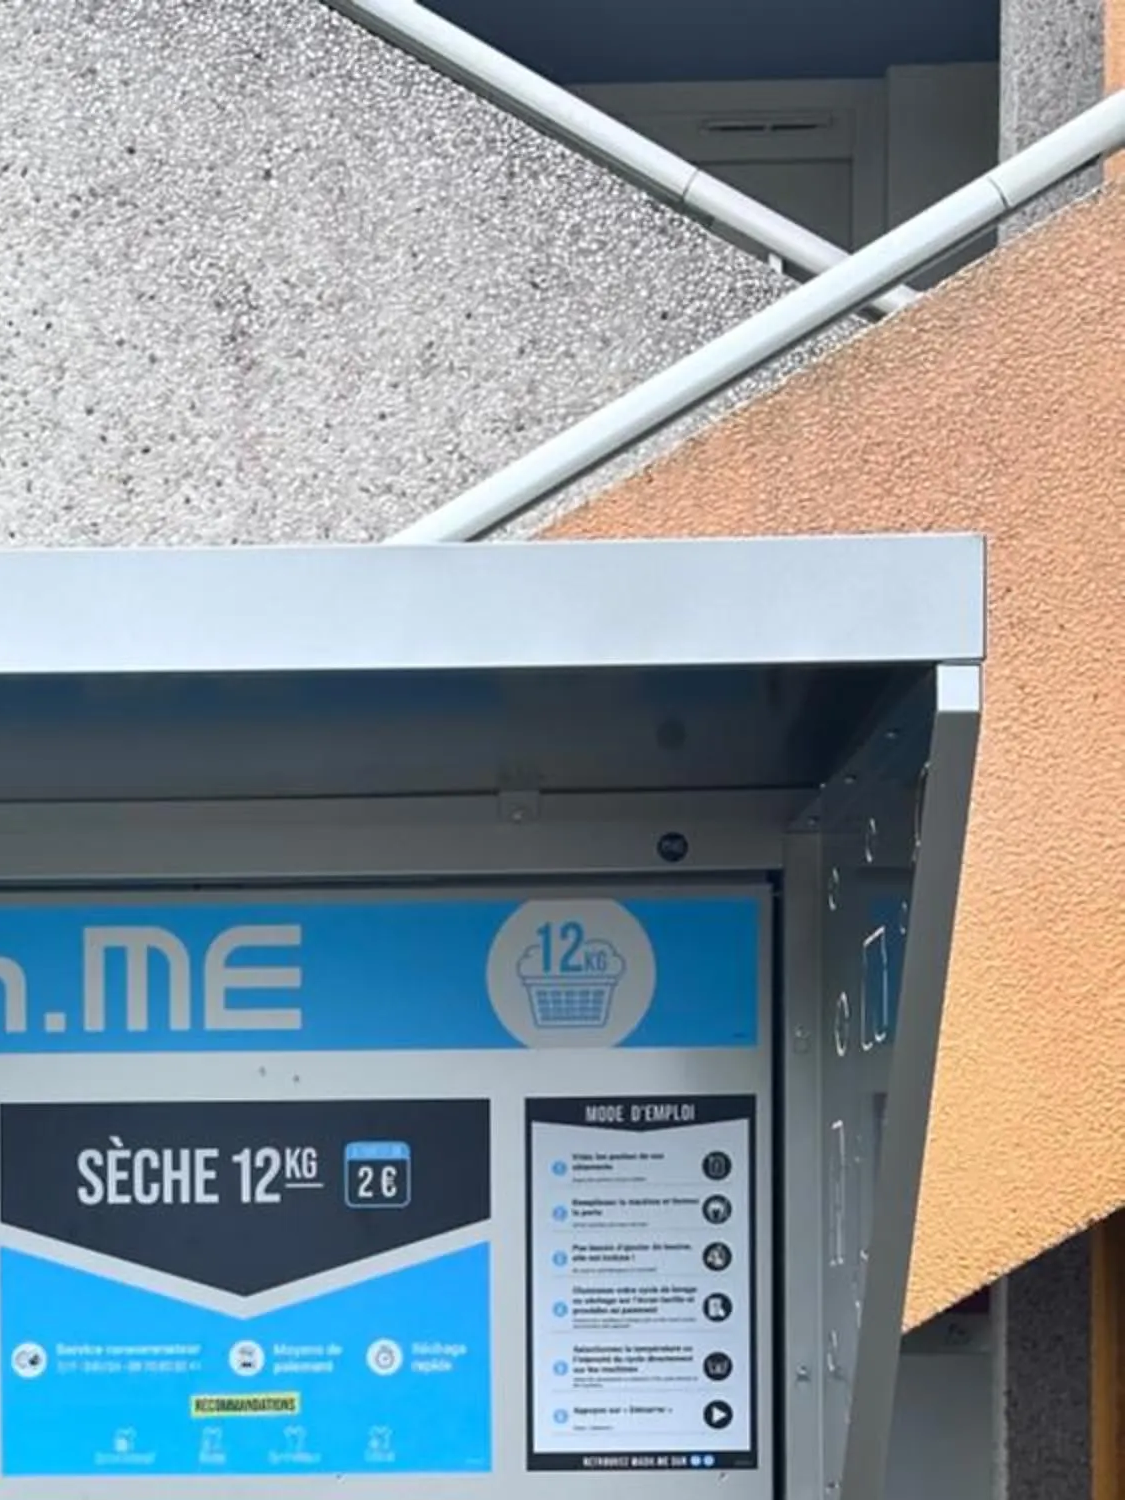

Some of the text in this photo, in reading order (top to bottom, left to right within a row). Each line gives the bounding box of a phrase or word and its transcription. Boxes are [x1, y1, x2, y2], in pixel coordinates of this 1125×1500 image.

[585, 1103, 695, 1122] MODE D'EMPLOI
[78, 1136, 218, 1205] SÈCHE
